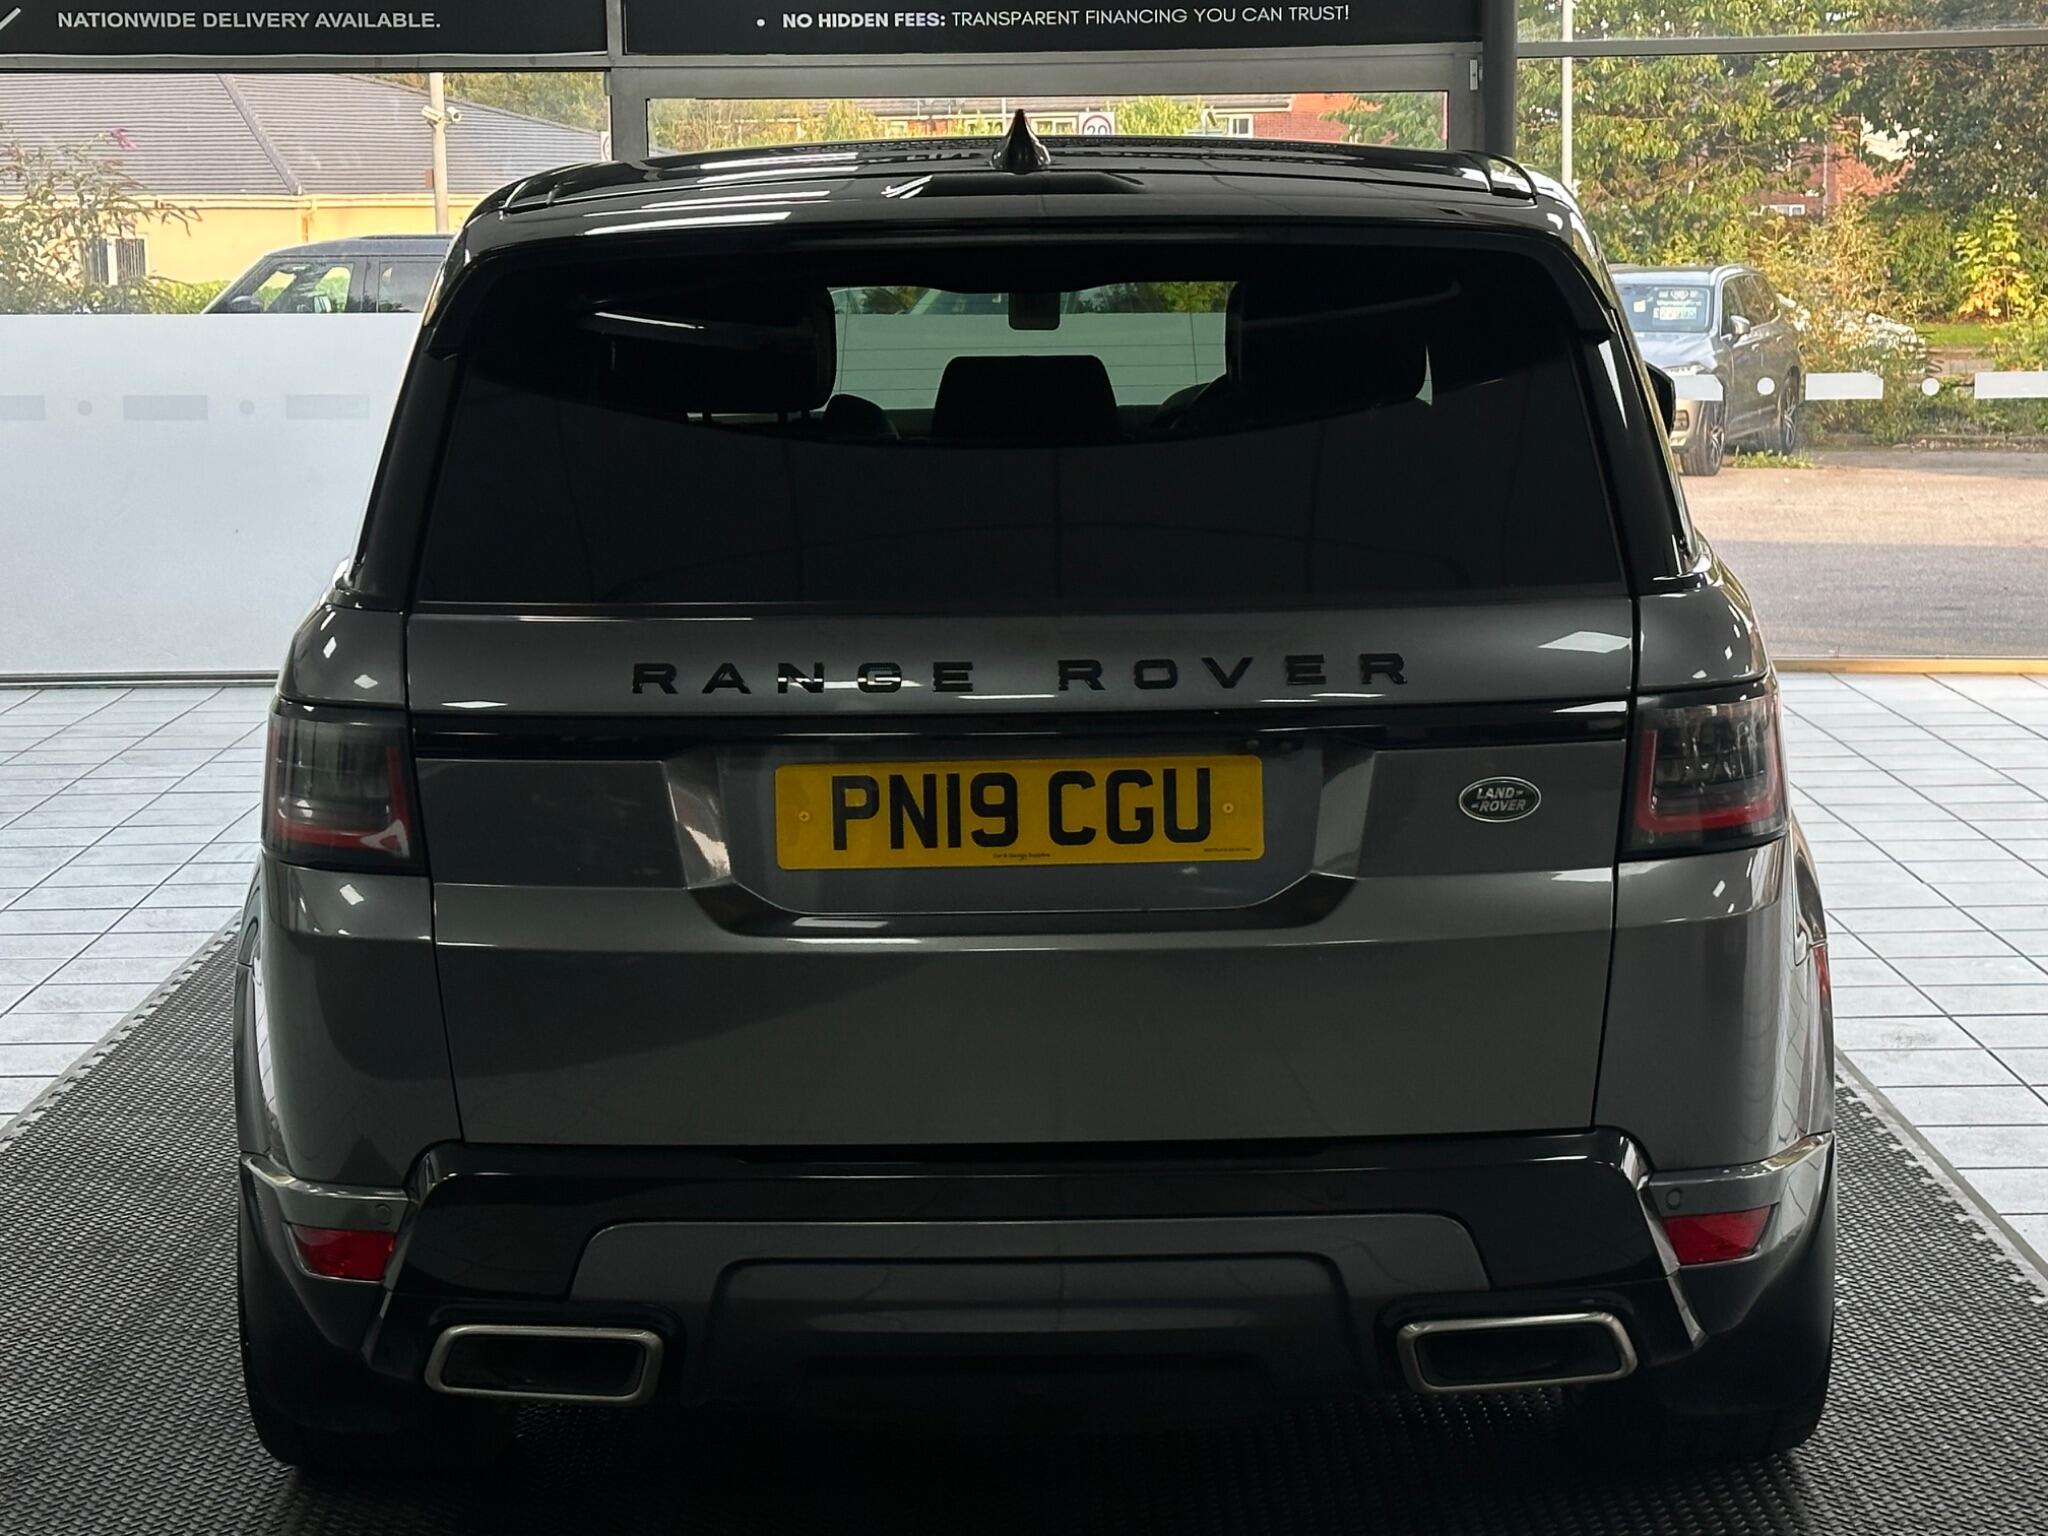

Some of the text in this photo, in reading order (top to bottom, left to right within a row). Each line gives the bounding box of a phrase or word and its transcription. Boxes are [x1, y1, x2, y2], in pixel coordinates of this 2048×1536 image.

[57, 12, 441, 28] NATIONWIDE DELIVERY AVAILABLE.
[782, 4, 1349, 29] NO HIDDEN FEES: TRANSPARENT FINANCING YOU CAN TRUST!
[632, 652, 1408, 695] RANGE ROVER
[1476, 786, 1515, 800] LAND
[831, 767, 1212, 851] PN19 CGU
[1478, 799, 1527, 812] ROVER
